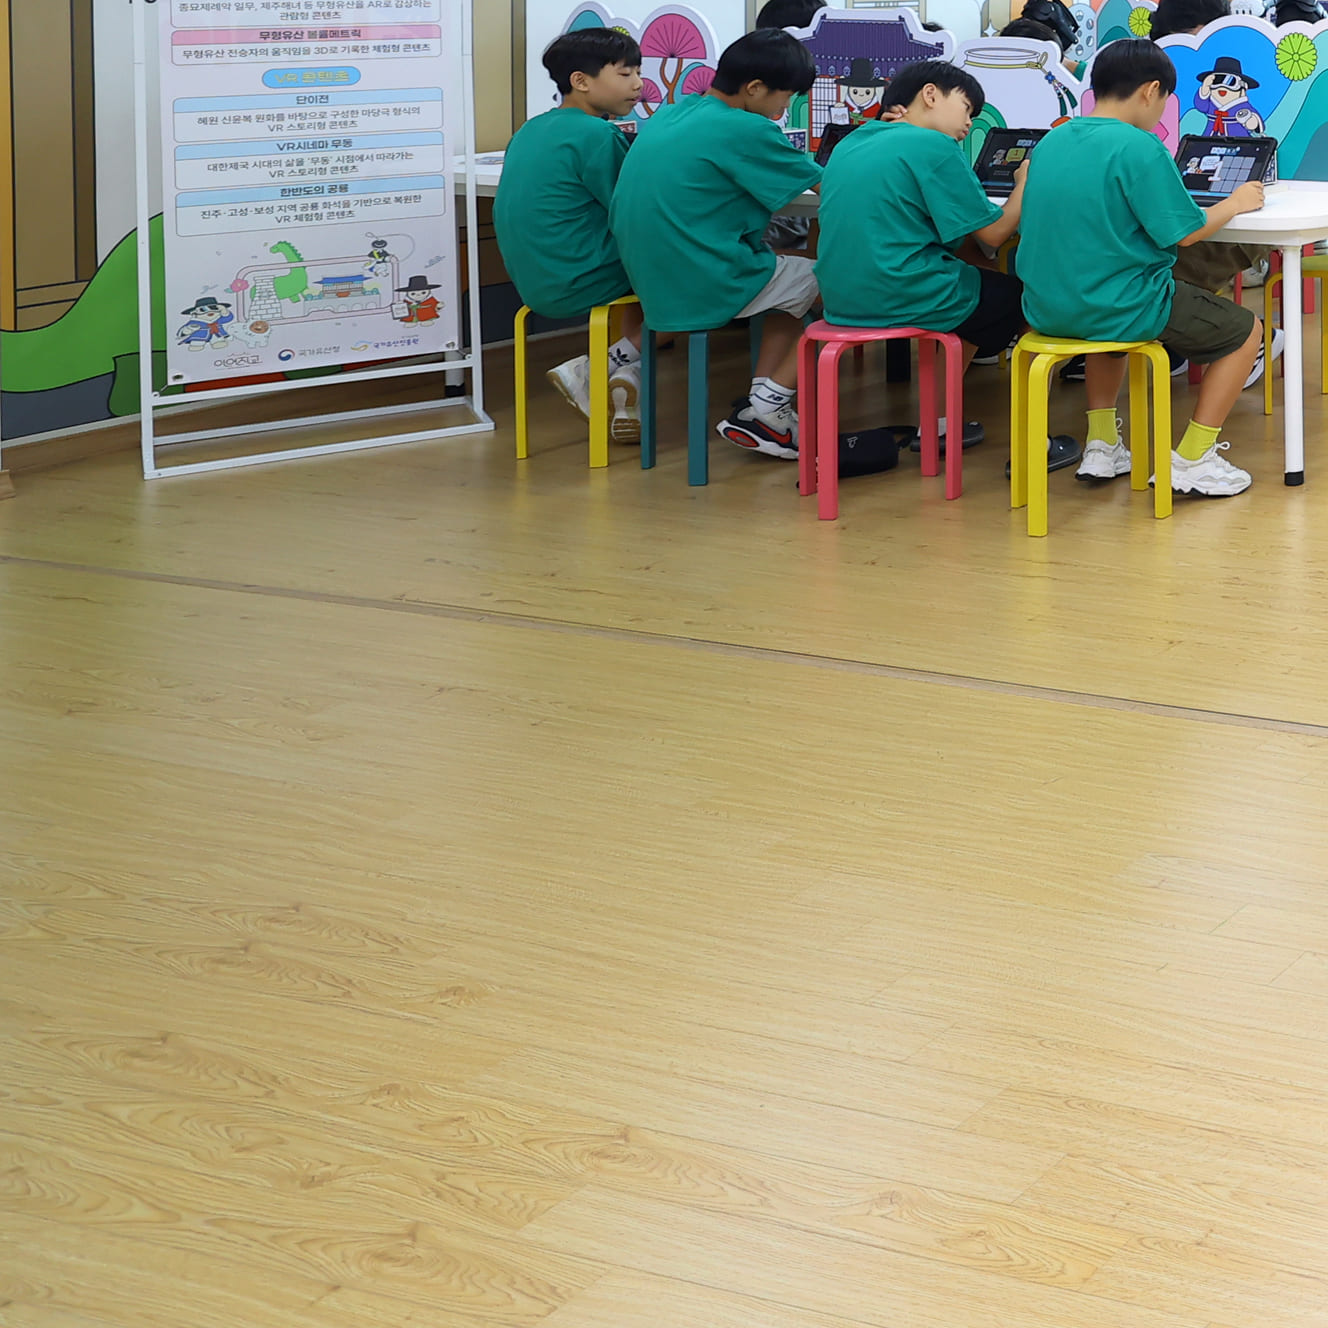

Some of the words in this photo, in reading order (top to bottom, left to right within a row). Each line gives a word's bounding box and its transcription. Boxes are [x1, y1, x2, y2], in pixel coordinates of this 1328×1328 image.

[178, 2, 231, 12] 종묘제례악
[260, 1, 301, 10] 제주해녀
[316, 0, 365, 9] 무형유산을
[367, 0, 393, 8] AR로
[311, 11, 342, 20] 콘텐츠
[259, 30, 304, 40] 무형유산
[183, 49, 225, 59] 무형유산
[227, 48, 269, 58] 전승자의
[314, 46, 338, 55] 3D로
[341, 45, 370, 54] 기록한
[372, 44, 400, 53] 체험형
[402, 43, 431, 53] 콘텐츠
[274, 73, 298, 83] VR
[296, 94, 329, 105] 단이전
[288, 111, 328, 121] 바탕으로
[330, 109, 359, 119] 구성한
[286, 121, 326, 131] 스토리형
[329, 120, 359, 129] 콘텐츠
[276, 140, 328, 151] VR시네마
[331, 138, 353, 148] 무동
[207, 161, 249, 172] 대한제국
[251, 159, 282, 169] 시대의
[376, 151, 414, 161] 따라가는
[287, 167, 327, 177] 스토리형
[330, 165, 359, 175] 콘텐츠
[280, 185, 324, 197] 한반도의
[327, 184, 348, 193] 공룡
[276, 203, 297, 213] 지역
[299, 202, 319, 212] 공룡
[353, 197, 392, 207] 기반으로
[394, 194, 422, 204] 복원한
[294, 212, 323, 222] 체험형
[326, 210, 355, 220] 콘텐츠
